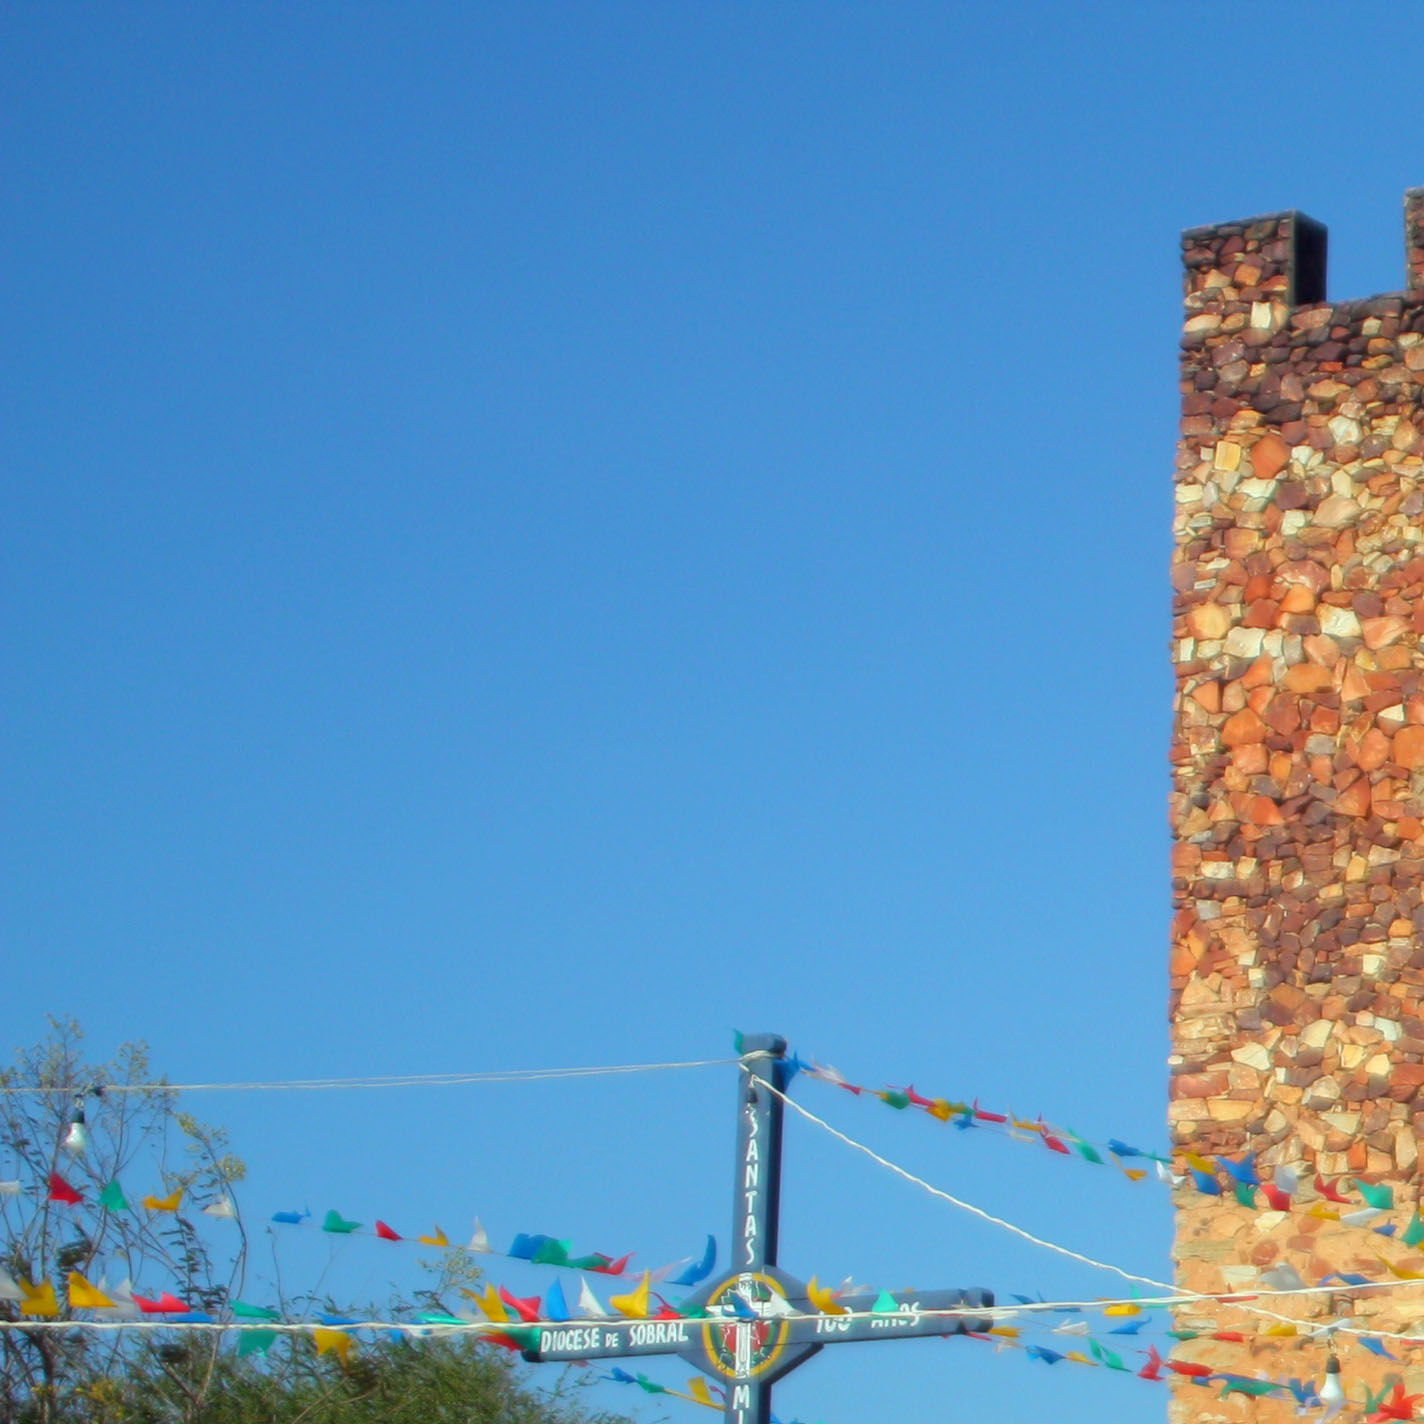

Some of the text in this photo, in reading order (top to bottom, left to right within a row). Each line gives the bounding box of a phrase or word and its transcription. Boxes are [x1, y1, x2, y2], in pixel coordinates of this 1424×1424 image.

[744, 1111, 759, 1266] SANTAS
[541, 1322, 689, 1353] DIOCESE DE SOBRAL
